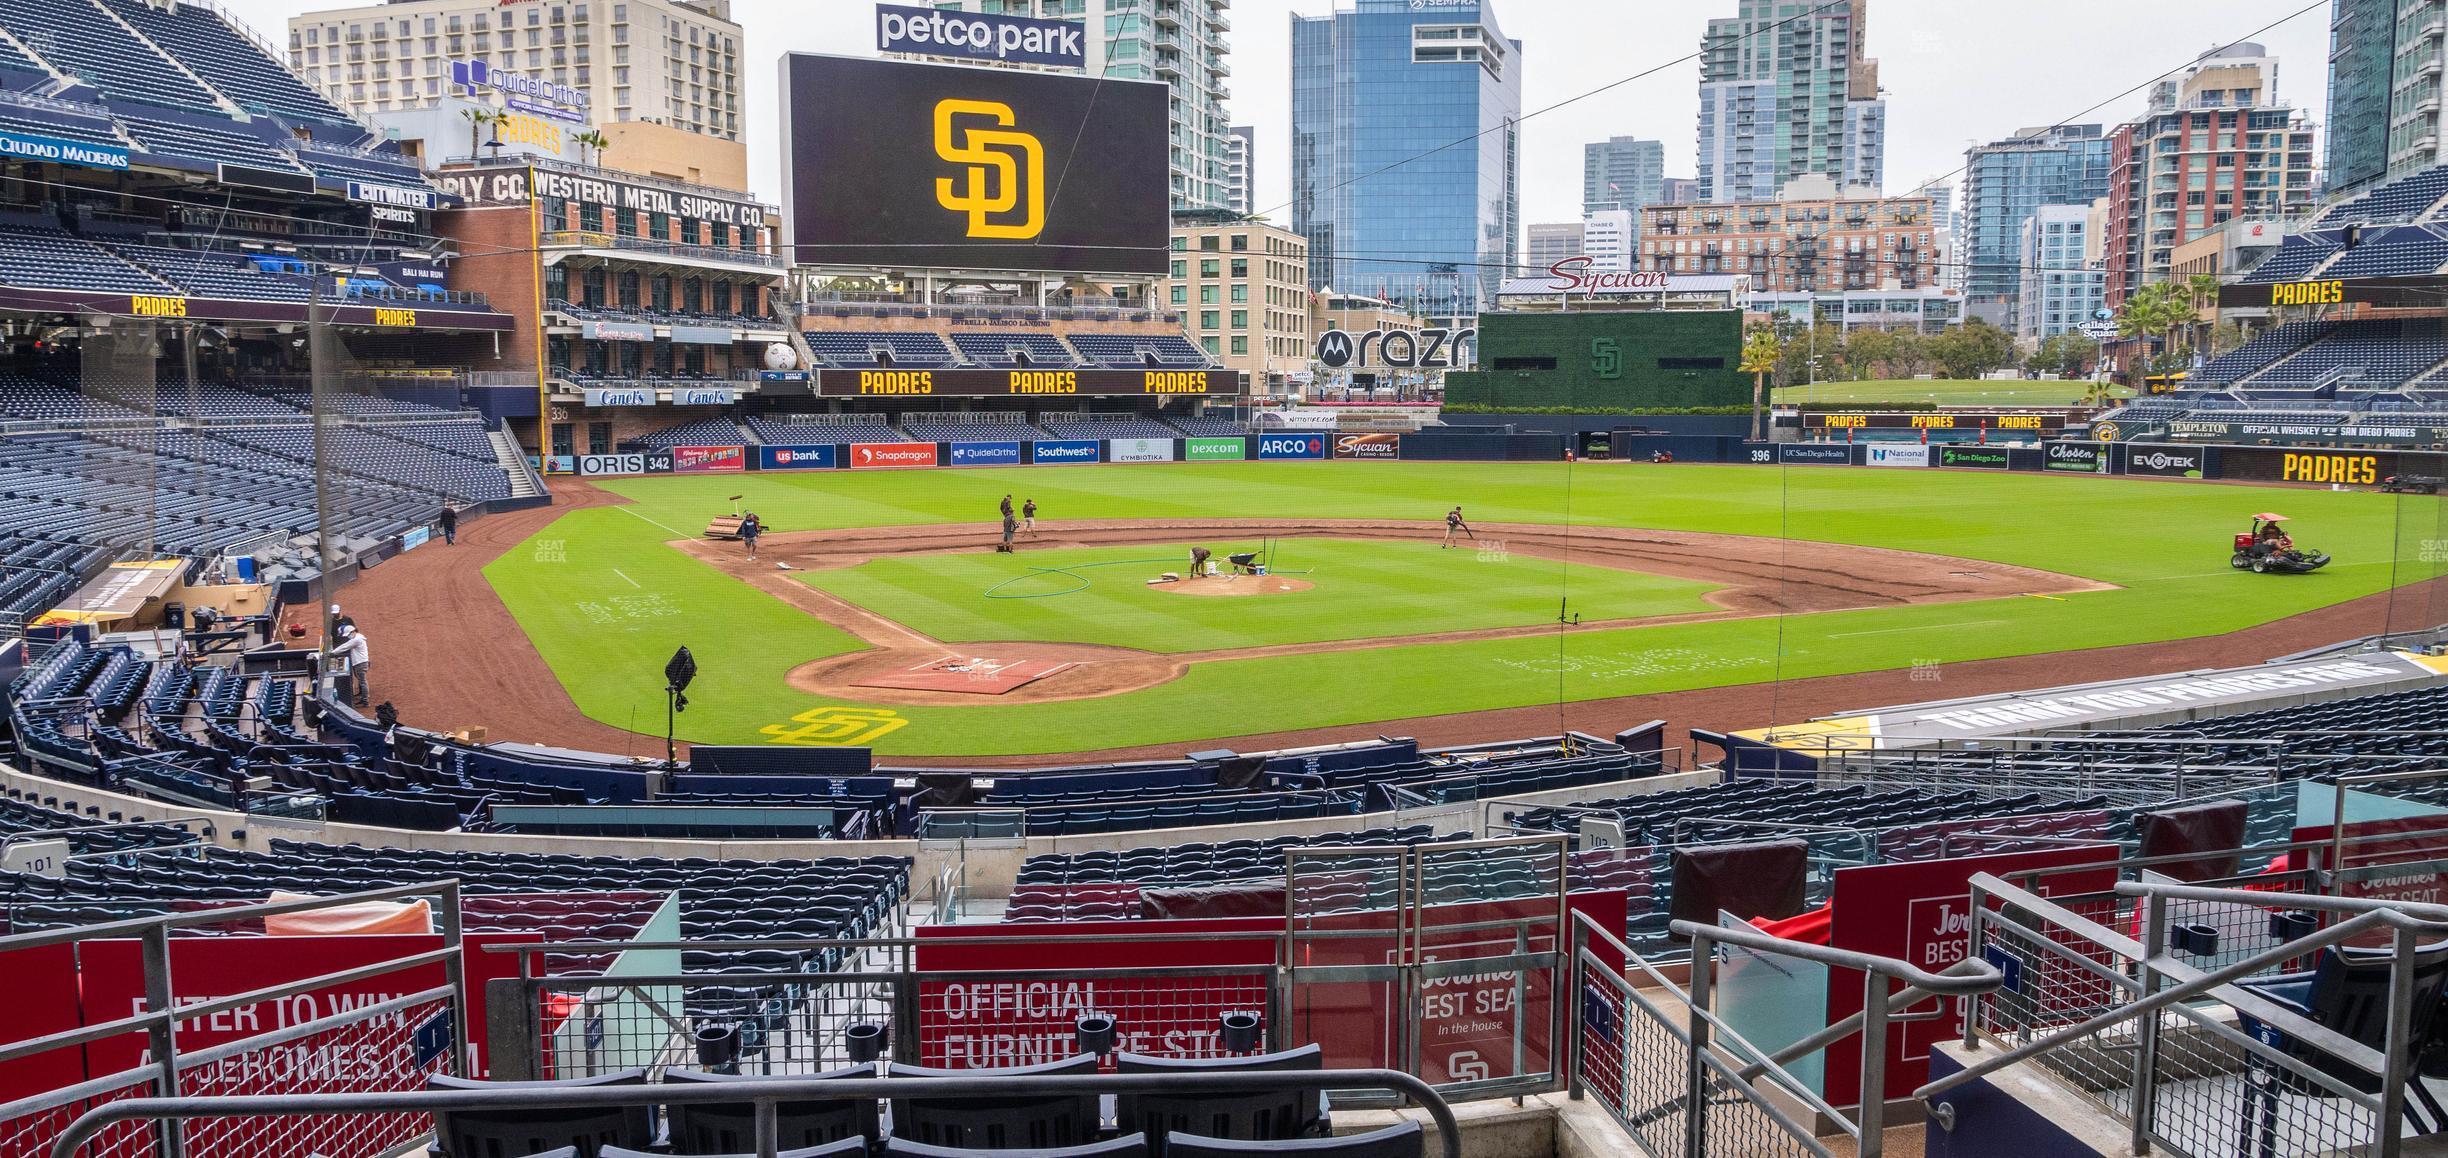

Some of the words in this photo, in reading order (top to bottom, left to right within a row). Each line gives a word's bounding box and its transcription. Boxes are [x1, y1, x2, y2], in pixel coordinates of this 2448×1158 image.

[882, 11, 991, 48] petco
[998, 24, 1081, 57] park
[490, 69, 584, 108] QuidelOrtho
[497, 113, 560, 155] PADRES
[0, 137, 59, 158] CIUDAD
[62, 145, 127, 167] MADERAS
[358, 183, 429, 208] CUTWATER
[492, 174, 530, 200] CO.
[533, 171, 617, 206] WESTERN
[624, 187, 678, 217] METAL
[680, 196, 735, 223] SUPPLY
[740, 206, 764, 229] CO.
[372, 206, 415, 223] SPIRITS
[402, 267, 417, 277] BALI
[418, 269, 429, 278] HAI
[430, 271, 444, 279] RUM
[1547, 256, 1670, 299] Sycuan
[2272, 280, 2343, 305] PADRES
[132, 295, 186, 317] PADRES
[375, 307, 416, 326] PADRES
[951, 319, 986, 327] ESTRELLA
[989, 319, 1017, 327] JALISCO
[1018, 320, 1050, 328] LANDING
[1358, 328, 1476, 368] razr
[861, 371, 932, 395] PADRES
[1010, 371, 1076, 395] PADRES
[1145, 371, 1207, 394] PADRES
[600, 391, 644, 405] Canel's
[687, 390, 725, 405] Canel's
[551, 407, 568, 421] 336
[1998, 416, 2042, 429] PADRES
[2170, 423, 2228, 434] TEMPLETON
[2243, 425, 2279, 434] OFFICIAL
[2281, 426, 2319, 435] WHISKEY
[2341, 427, 2357, 436] SAN
[2358, 427, 2382, 437] DIEGO
[2384, 428, 2416, 437] PADRES
[777, 451, 789, 461] us
[791, 449, 820, 461] bank
[967, 447, 1017, 457] QuidelOrtho
[1037, 446, 1088, 457] Southwest
[1261, 440, 1306, 454] ARCO
[1337, 436, 1393, 457] Sycuan
[1808, 450, 1824, 458] Diego
[1825, 450, 1845, 458] Health
[1889, 449, 1925, 458] National
[2050, 444, 2094, 458] Chosen
[649, 457, 669, 470] 342
[876, 450, 932, 463] Snapdragon
[1751, 449, 1770, 462] 396
[1971, 454, 1991, 463] Diego
[2133, 452, 2195, 470] EVOTEK
[583, 456, 642, 474] ORIS
[2283, 453, 2377, 485] PADRES
[26, 856, 53, 873] 101
[944, 982, 1106, 1019] OFFICIAL
[274, 993, 320, 1028] TO
[1438, 1024, 1449, 1036] In
[1451, 1022, 1468, 1034] the
[1471, 1020, 1503, 1033] house
